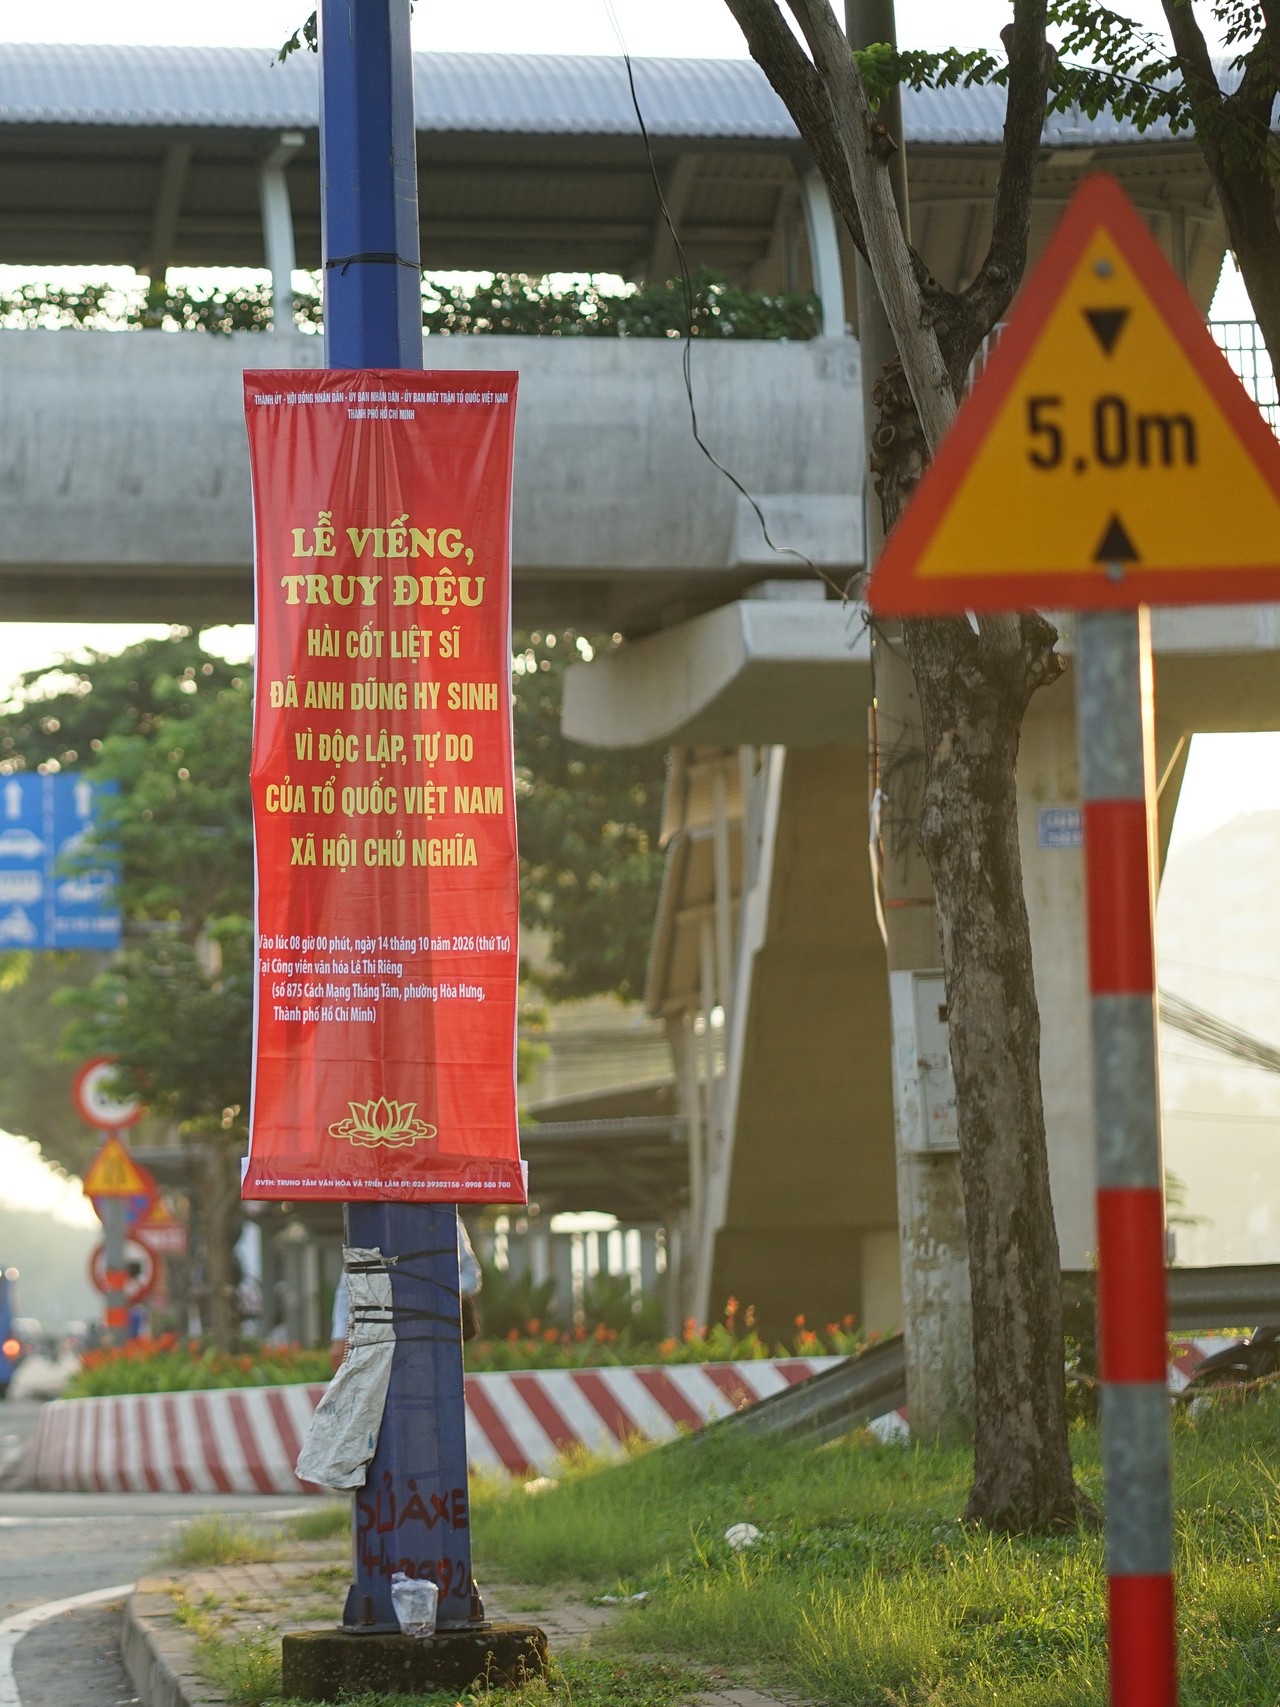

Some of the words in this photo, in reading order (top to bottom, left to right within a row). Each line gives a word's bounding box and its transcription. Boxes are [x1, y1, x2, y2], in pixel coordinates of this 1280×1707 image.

[254, 393, 274, 405] THÀNH
[287, 392, 297, 406] HỘI
[314, 391, 331, 403] NHÂN
[332, 391, 344, 403] DÂN
[357, 391, 370, 402] BAN
[371, 390, 386, 402] NHÂN
[388, 390, 400, 403] DÂN
[413, 392, 426, 403] BAN
[440, 391, 455, 405] TRẬN
[465, 389, 480, 404] QUỐC
[481, 391, 493, 405] VIỆT
[494, 392, 509, 403] NAM
[347, 407, 366, 419] THÀNH
[367, 405, 379, 419] PHỐ
[389, 407, 398, 419] CHÍ
[399, 409, 415, 420] MINH
[291, 510, 337, 558] LỄ
[346, 513, 474, 566] VIẾNG,
[280, 574, 383, 605] TRUY
[392, 566, 486, 615] ĐIỆU
[307, 623, 340, 658] HÀI
[346, 621, 384, 659] CỐT
[391, 624, 433, 664] LIỆT
[438, 625, 461, 658] SĨ
[270, 675, 299, 708] ĐÃ
[304, 681, 344, 710] ANH
[350, 677, 407, 711] DŨNG
[414, 682, 441, 710] HY
[447, 682, 498, 711] SINH
[294, 727, 313, 761] VÌ
[318, 729, 359, 768] ĐỘC
[365, 729, 407, 768] LẬP,
[412, 731, 441, 768] TỰ
[445, 733, 474, 762] DO
[265, 775, 306, 813] CỦA
[311, 775, 336, 815] TỔ
[341, 777, 398, 817] QUỐC
[403, 781, 448, 821] VIỆT
[454, 786, 504, 815] NAM
[290, 833, 317, 866] XÃ
[322, 833, 357, 873] HỘI
[364, 830, 406, 867] CHỦ
[412, 833, 478, 867] NGHĨA
[275, 934, 289, 950] lúc
[290, 936, 300, 950] 08
[302, 936, 315, 954] giờ
[316, 936, 327, 950] 00
[329, 936, 353, 954] phút,
[355, 936, 376, 954] ngày
[378, 936, 388, 950] 14
[390, 936, 416, 954] tháng
[418, 936, 429, 950] 10
[430, 936, 450, 950] năm
[452, 936, 474, 951] 2026
[476, 936, 495, 953] (thứ
[496, 936, 510, 953] Tư)
[272, 958, 293, 977] Công
[294, 959, 313, 974] viên
[314, 959, 330, 974] văn
[332, 959, 349, 974] hóa
[350, 959, 361, 974] Lê
[362, 959, 376, 978] Thị
[378, 959, 403, 978] Riêng
[272, 981, 286, 999] (số
[286, 983, 302, 998] 875
[304, 983, 324, 998] Cách
[326, 983, 351, 1001] Mạng
[352, 983, 379, 1001] Tháng
[381, 983, 402, 1000] Tám,
[403, 983, 438, 1002] phường
[440, 983, 457, 998] Hòa
[459, 983, 486, 1002] Hưng,
[273, 1005, 301, 1021] Thành
[302, 1005, 320, 1024] phố
[321, 1005, 333, 1021] Hồ
[335, 1006, 349, 1022] Chí
[350, 1006, 376, 1024] Minh)
[335, 1178, 351, 1187] HÓA
